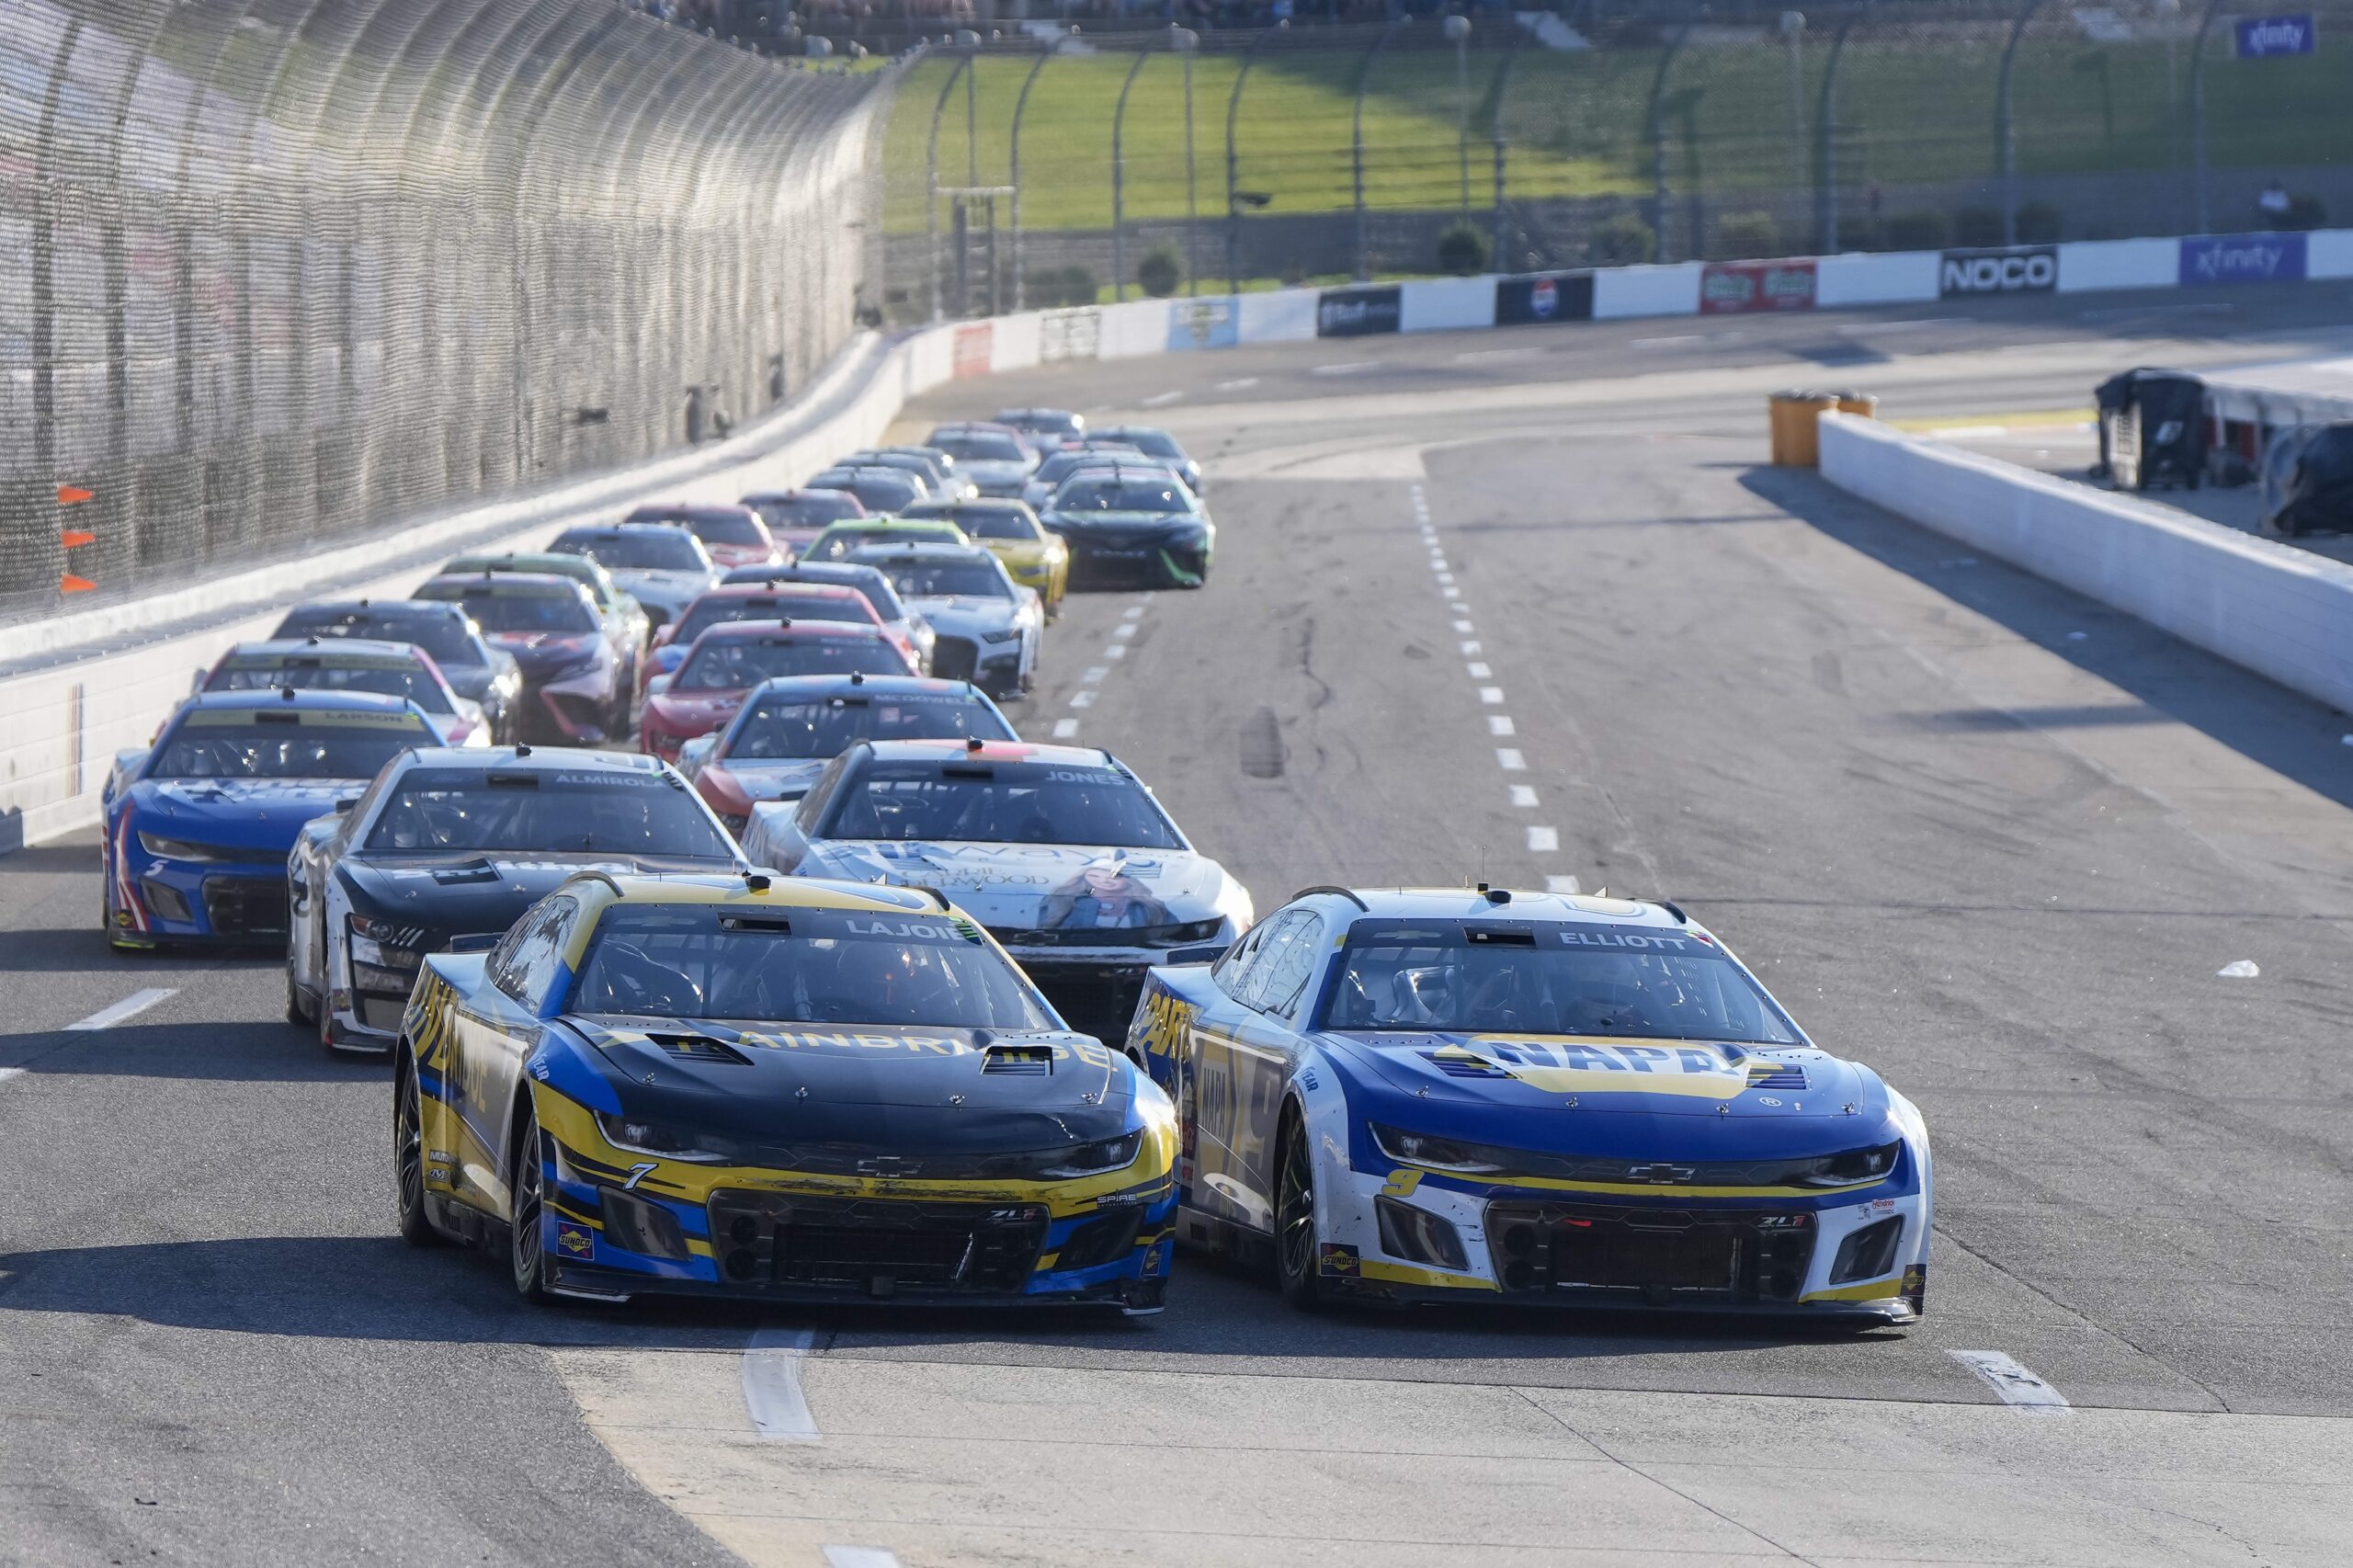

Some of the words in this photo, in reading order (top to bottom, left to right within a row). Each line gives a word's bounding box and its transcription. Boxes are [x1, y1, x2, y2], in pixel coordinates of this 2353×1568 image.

[2196, 243, 2283, 278] xfinity
[1942, 256, 2053, 290] NOCO
[324, 711, 403, 723] LARSON
[555, 774, 666, 788] ALMIROLA
[1045, 771, 1126, 786] JONES
[143, 858, 170, 877] 5
[846, 919, 966, 941] LAJOIE
[1558, 932, 1687, 951] ELLIOTT
[1487, 1040, 1740, 1075] NAPA
[1201, 1066, 1227, 1140] NAPA
[622, 1162, 660, 1192] 7
[1381, 1168, 1426, 1199] 9
[1097, 1192, 1138, 1204] SPIRE
[986, 1208, 1037, 1221] ZL1
[1756, 1214, 1806, 1228] ZL1
[560, 1234, 591, 1248] SUNOCO
[1324, 1256, 1358, 1266] SUNOCO
